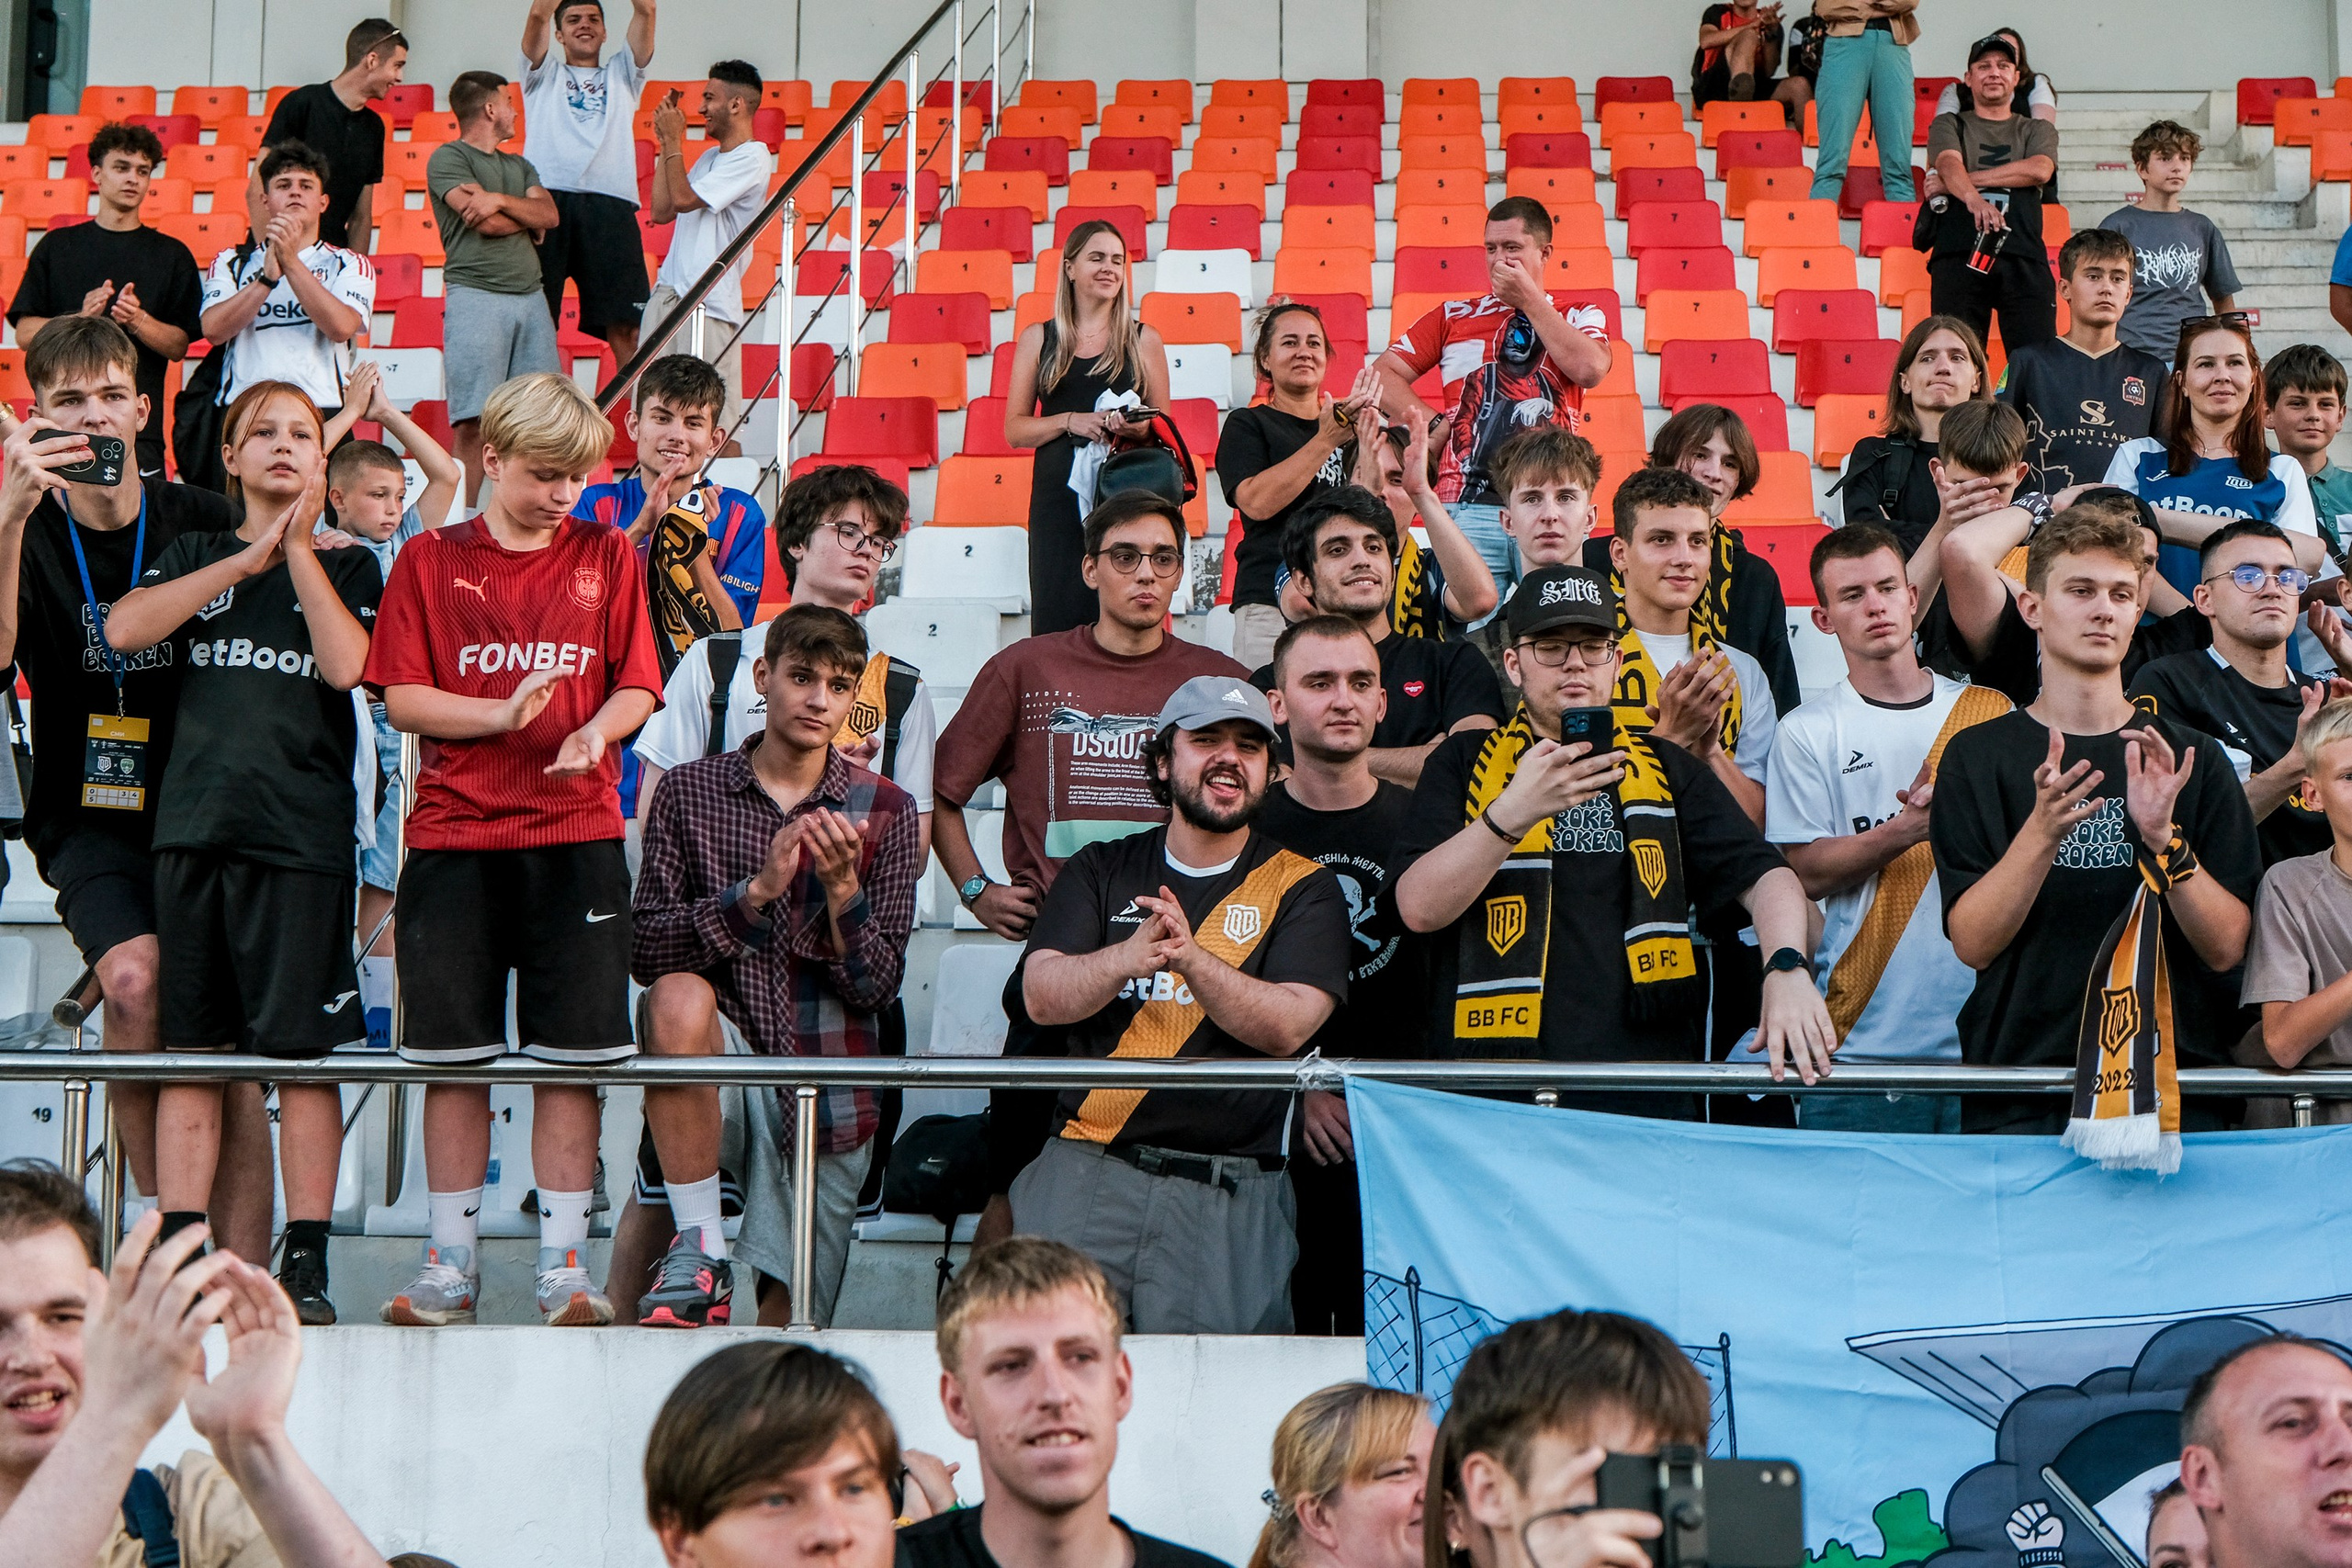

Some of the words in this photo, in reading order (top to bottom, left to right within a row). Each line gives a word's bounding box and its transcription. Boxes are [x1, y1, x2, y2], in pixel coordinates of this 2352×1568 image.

[1437, 178, 1445, 188] 5
[1440, 259, 1448, 270] 5
[1680, 260, 1689, 270] 7
[1803, 259, 1811, 269] 8
[1692, 302, 1701, 312] 7
[1710, 353, 1718, 364] 7
[1583, 412, 1591, 423] 6
[1868, 409, 1876, 420] 8
[2050, 428, 2096, 437] SAINT
[994, 473, 1002, 485] 2
[964, 545, 973, 558] 2
[1767, 543, 1776, 553] 7
[719, 573, 761, 593] MBILIGH
[928, 624, 937, 637] 2
[459, 641, 597, 677] FONBET
[1073, 732, 1158, 760] DSQUA
[1842, 761, 1874, 773] DEMIX
[1110, 915, 1146, 924] DEMIX
[1660, 950, 1678, 967] FC
[1467, 1010, 1494, 1028] BB
[1500, 1007, 1529, 1026] FC
[2089, 1067, 2138, 1096] 2022
[32, 1107, 52, 1123] 19
[502, 1107, 512, 1123] 1
